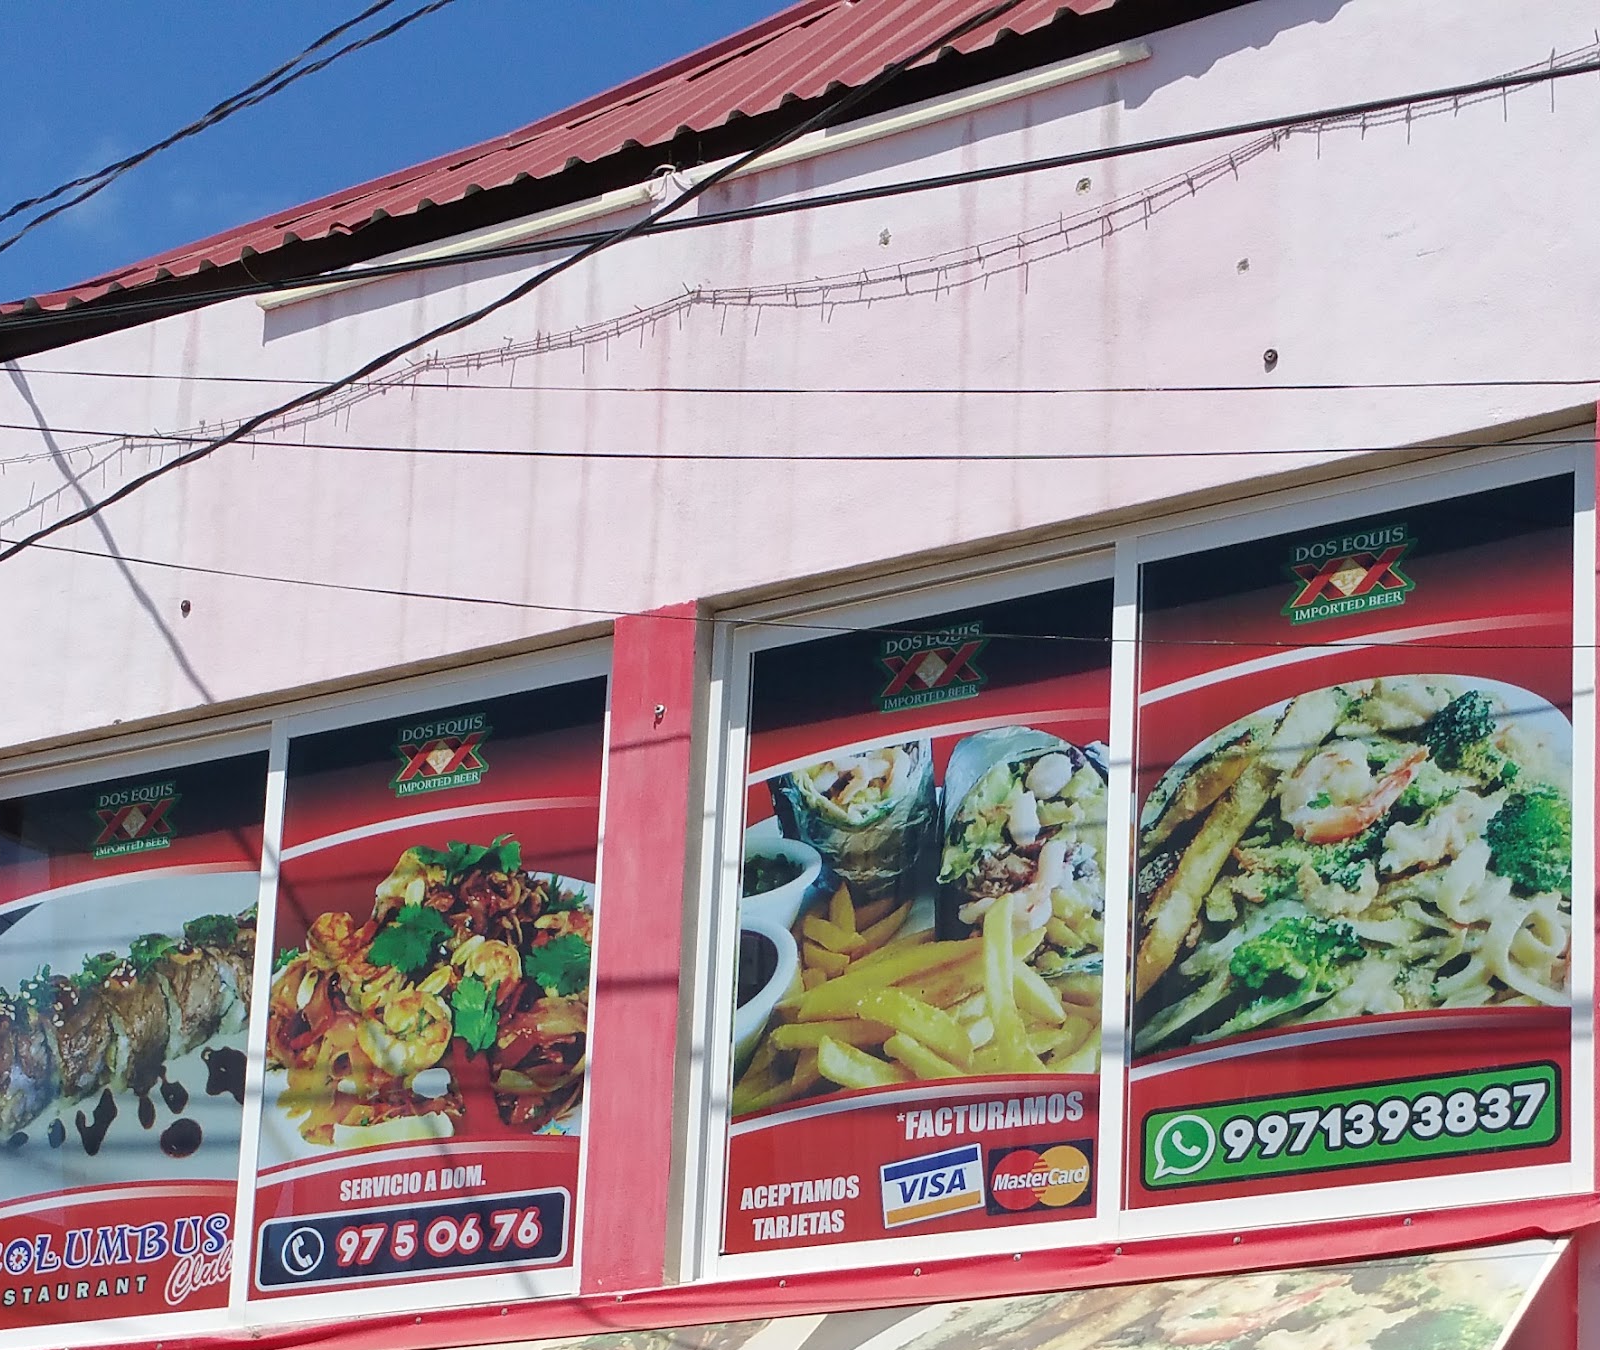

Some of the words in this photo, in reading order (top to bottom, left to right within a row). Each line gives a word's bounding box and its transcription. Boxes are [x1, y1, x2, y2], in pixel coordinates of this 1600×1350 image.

[1294, 540, 1338, 562] DOS
[1341, 526, 1406, 553] EQUIS
[1294, 602, 1366, 621] IMPORTED
[1367, 591, 1403, 608] BEER
[885, 636, 921, 654] DOS
[883, 690, 945, 710] IMPORTED
[946, 683, 979, 699] BEER
[401, 723, 434, 743] DOS
[436, 714, 484, 738] EQUIS
[99, 790, 129, 808] DOS
[130, 783, 175, 803] EQUIS
[398, 776, 451, 795] IMPORTED
[453, 771, 481, 786] BEER
[96, 839, 144, 859] IMPORTED
[145, 836, 170, 849] BEER
[1221, 1081, 1547, 1160] 9971393837
[340, 1171, 420, 1202] SERVICIO
[423, 1170, 437, 1192] A
[440, 1164, 487, 1190] DOM.
[739, 1175, 860, 1212] ACEPTAMOS
[897, 1167, 968, 1205] VISA
[993, 1163, 1088, 1192] MasterCard
[338, 1226, 386, 1264] 97
[394, 1224, 416, 1258] 5
[428, 1217, 481, 1254] 06
[493, 1210, 540, 1247] 76
[752, 1209, 845, 1242] TARJETAS
[164, 1240, 232, 1306] Club
